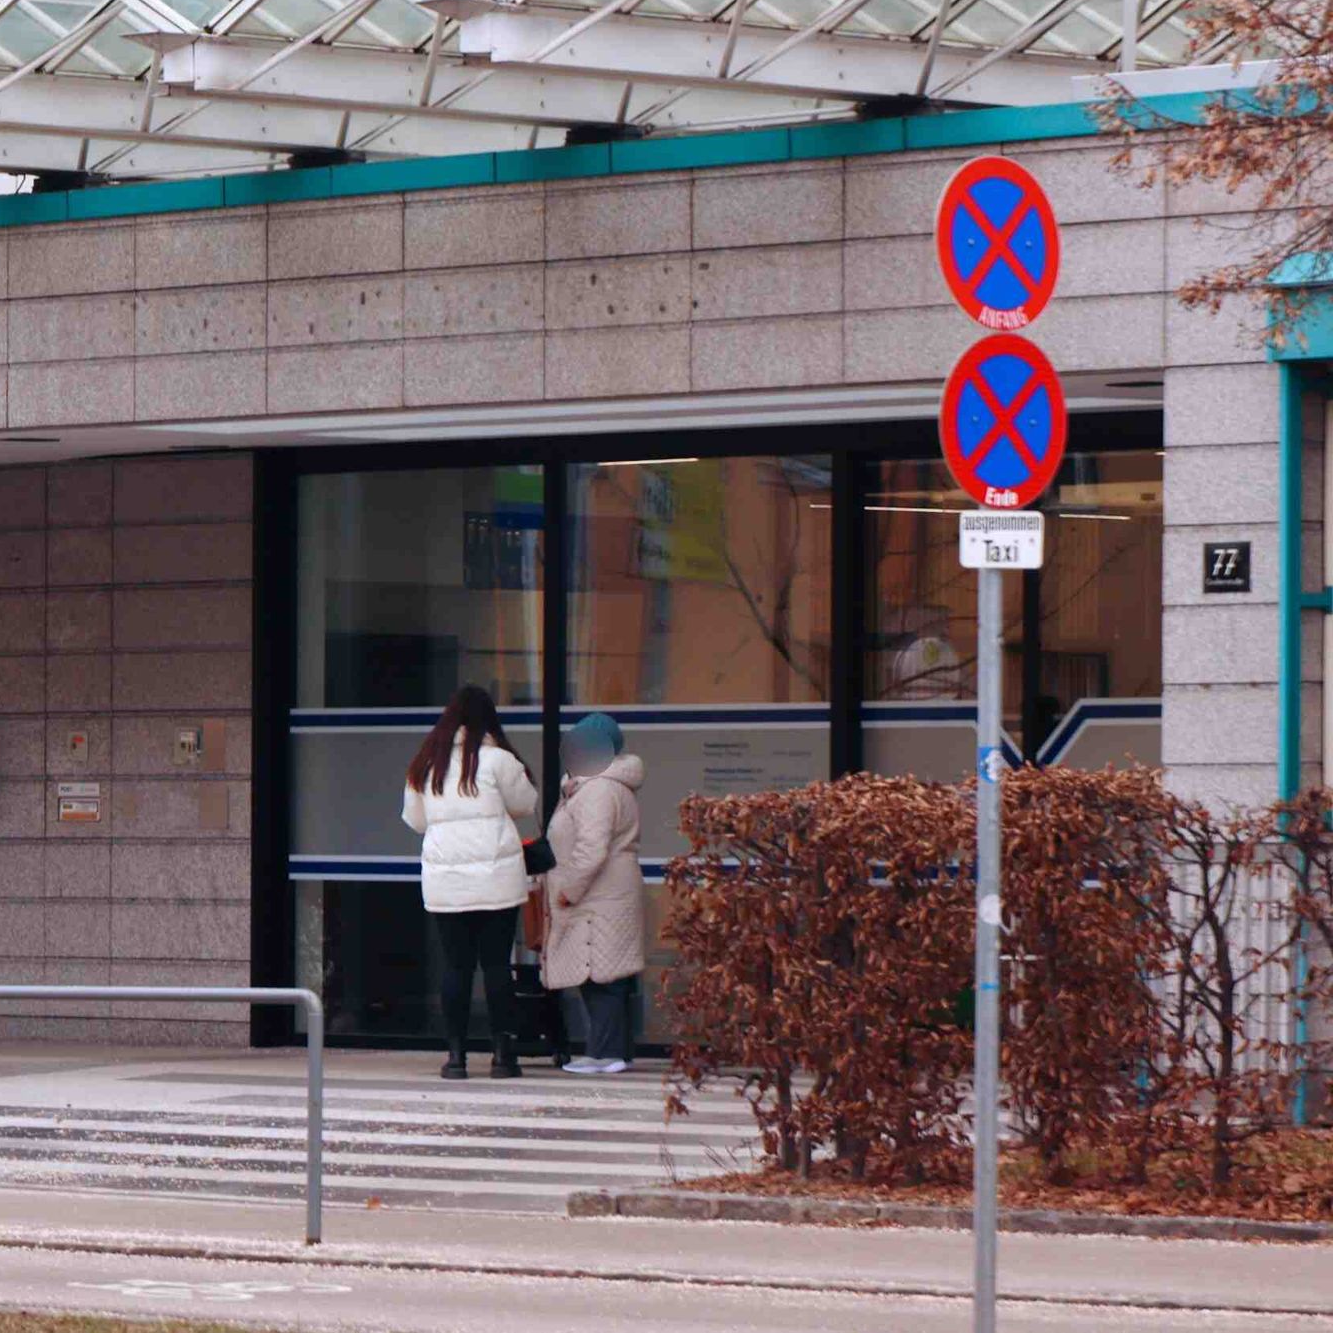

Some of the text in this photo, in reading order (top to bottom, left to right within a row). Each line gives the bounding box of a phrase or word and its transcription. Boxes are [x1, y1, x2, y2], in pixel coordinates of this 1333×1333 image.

[985, 486, 1019, 507] Ende
[964, 516, 1040, 534] ausgenommen
[983, 539, 1019, 563] Taxi
[1212, 548, 1239, 576] 77
